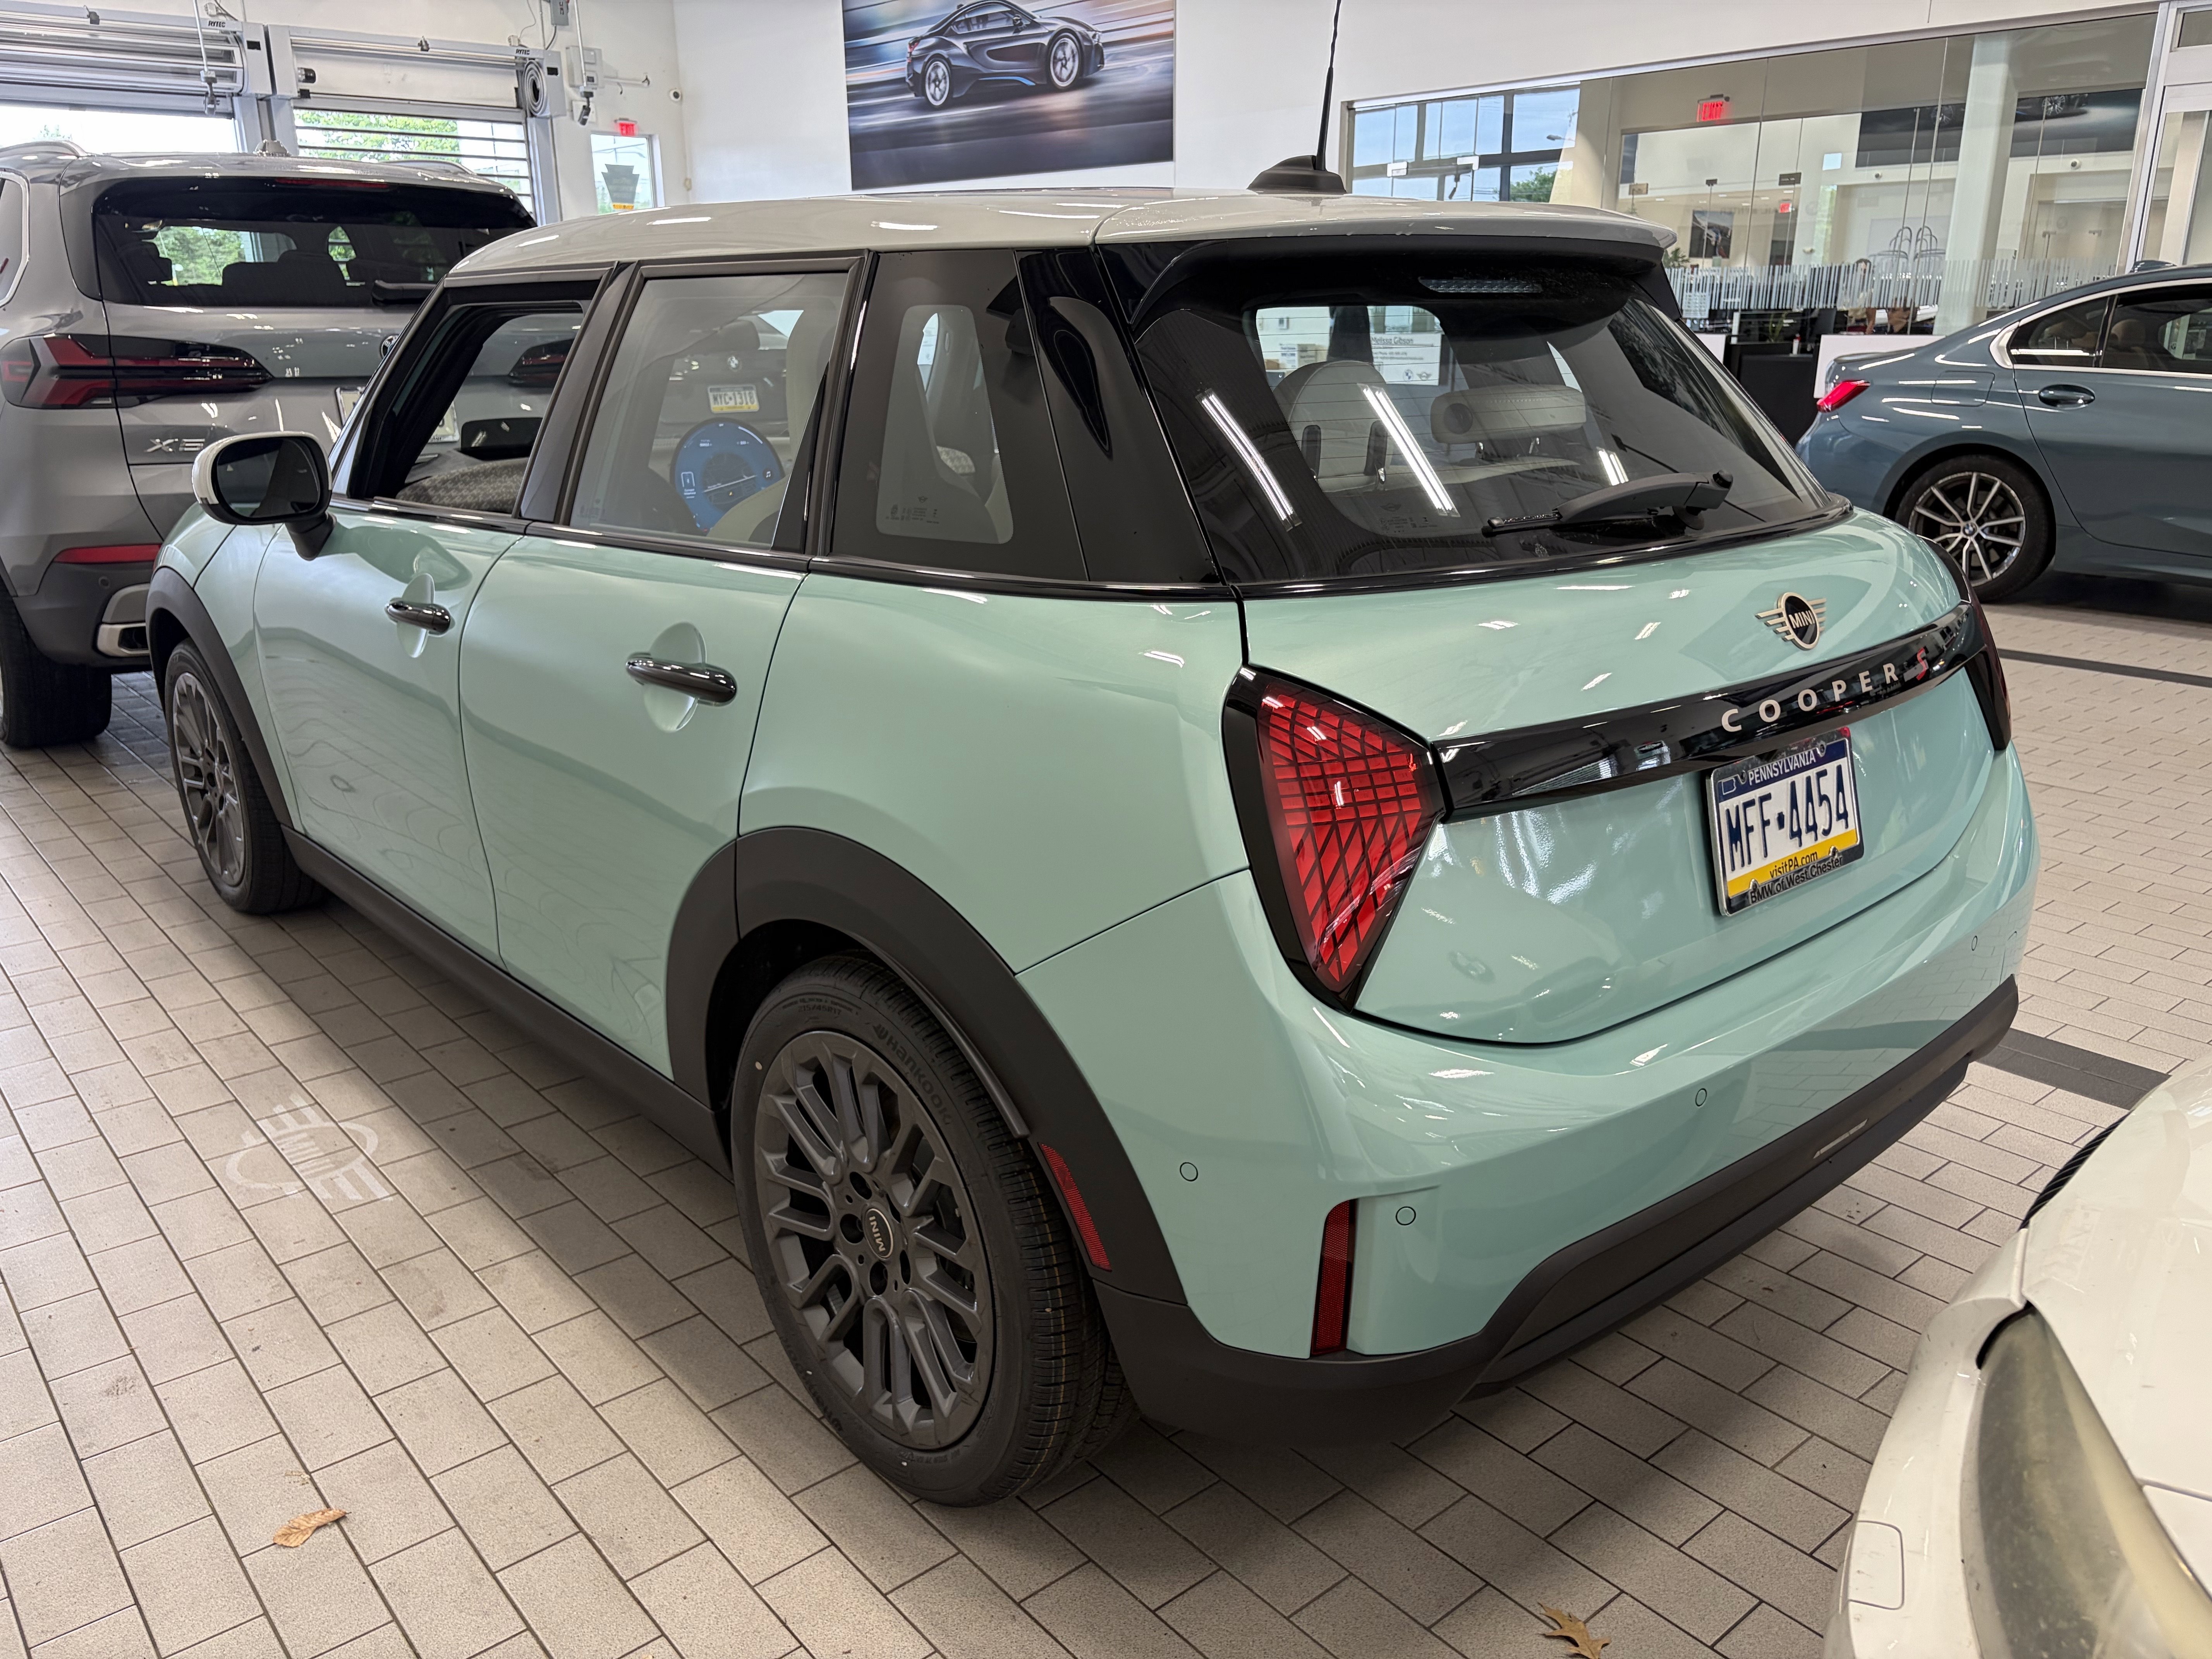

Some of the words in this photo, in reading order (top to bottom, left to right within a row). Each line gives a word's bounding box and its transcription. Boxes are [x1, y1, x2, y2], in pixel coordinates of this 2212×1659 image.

[1702, 101, 1723, 121] EXIT
[143, 438, 205, 452] X5
[1788, 610, 1815, 629] MINI
[1721, 663, 1898, 732] COOPER
[1916, 647, 1928, 680] S
[1749, 750, 1816, 786] PENNSYLVANIA
[1750, 883, 1773, 903] BMW
[1776, 878, 1785, 891] of
[1786, 870, 1808, 887] West
[1810, 856, 1843, 877] Chester
[1770, 851, 1818, 878] visitPA.com
[869, 1216, 886, 1252] MINI
